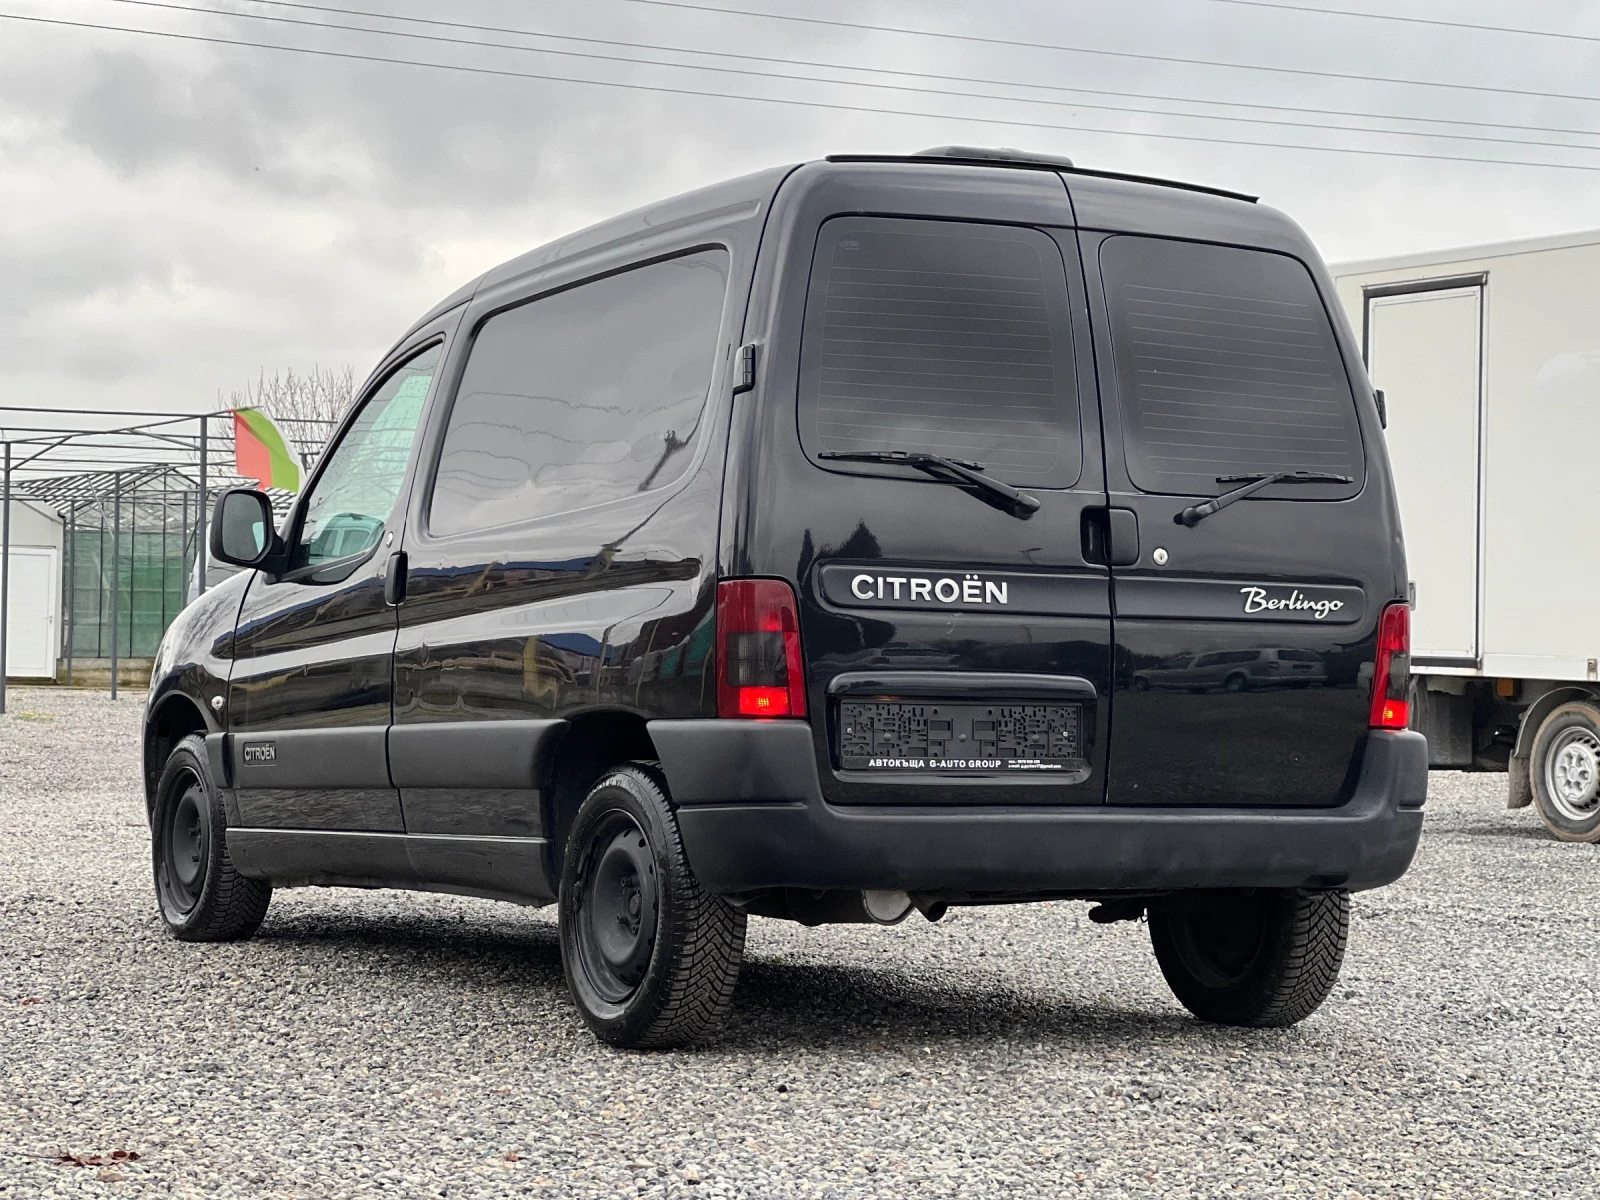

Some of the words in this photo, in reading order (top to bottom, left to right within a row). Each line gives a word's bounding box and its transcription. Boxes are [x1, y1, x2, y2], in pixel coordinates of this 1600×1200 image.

[851, 574, 1008, 604] CITROËN
[1240, 587, 1344, 619] Berlingo
[244, 744, 275, 761] CITROËN
[868, 758, 925, 768] АВТОКЪЩА
[929, 759, 966, 768] G-AUTO
[968, 760, 1002, 768] GROUP
